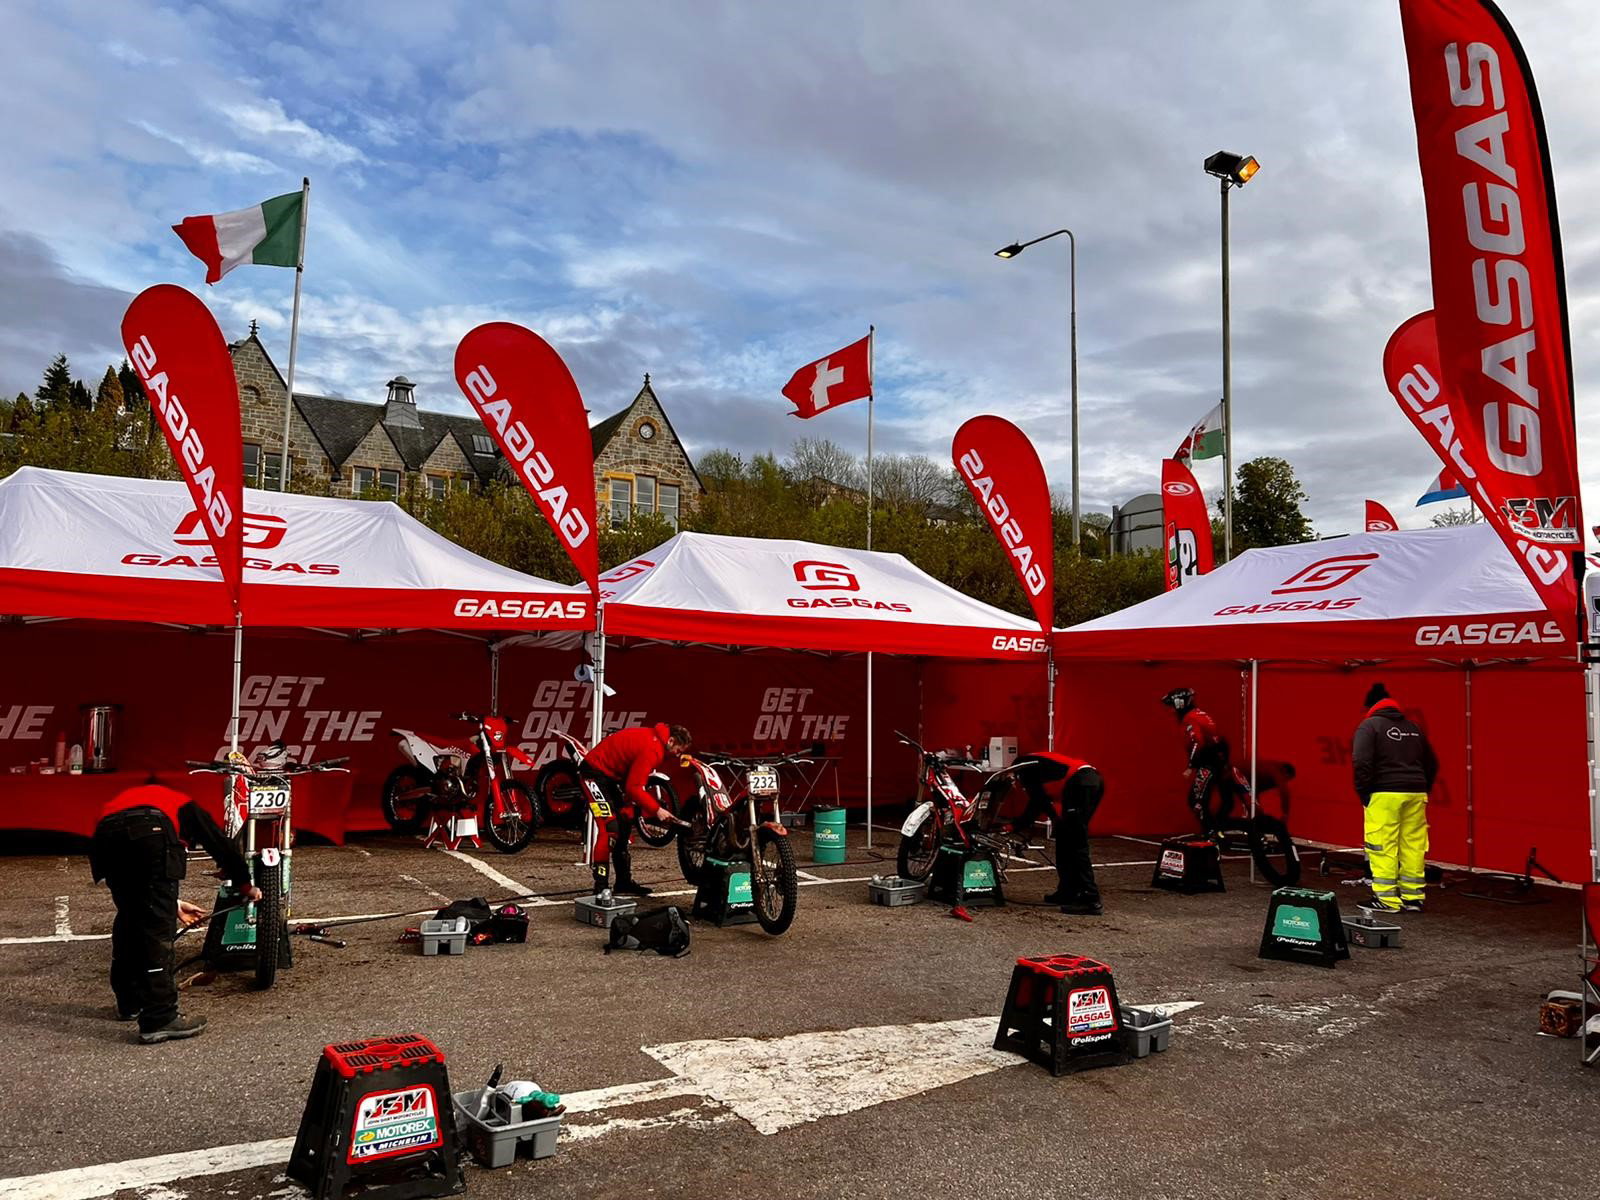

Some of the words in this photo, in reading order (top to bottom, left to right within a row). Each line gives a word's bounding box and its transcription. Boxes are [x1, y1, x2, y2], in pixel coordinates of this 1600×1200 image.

[1444, 41, 1543, 477] GASGAS
[120, 553, 341, 576] GASGAS
[454, 598, 586, 619] GASGAS
[787, 597, 912, 613] GASGAS
[1213, 597, 1362, 616] GASGAS
[1415, 621, 1566, 646] GASGAS
[239, 675, 326, 707] GET
[532, 680, 595, 708] GET
[760, 687, 813, 713] GET
[0, 705, 55, 740] HE
[224, 710, 291, 742] ON
[302, 711, 382, 742] THE
[521, 711, 574, 739] ON
[753, 714, 793, 740] ON
[800, 715, 850, 740] THE
[753, 776, 774, 789] 232
[254, 792, 286, 807] 230
[1282, 919, 1310, 927] MOTOREX
[1278, 937, 1316, 946] Polisport
[1072, 991, 1105, 1007] JSM
[1070, 1011, 1110, 1024] GASGAS
[1073, 1033, 1111, 1045] Polisport
[365, 1090, 427, 1118] JSM
[376, 1120, 431, 1139] MOTOREX
[378, 1134, 428, 1150] MICHELIN
